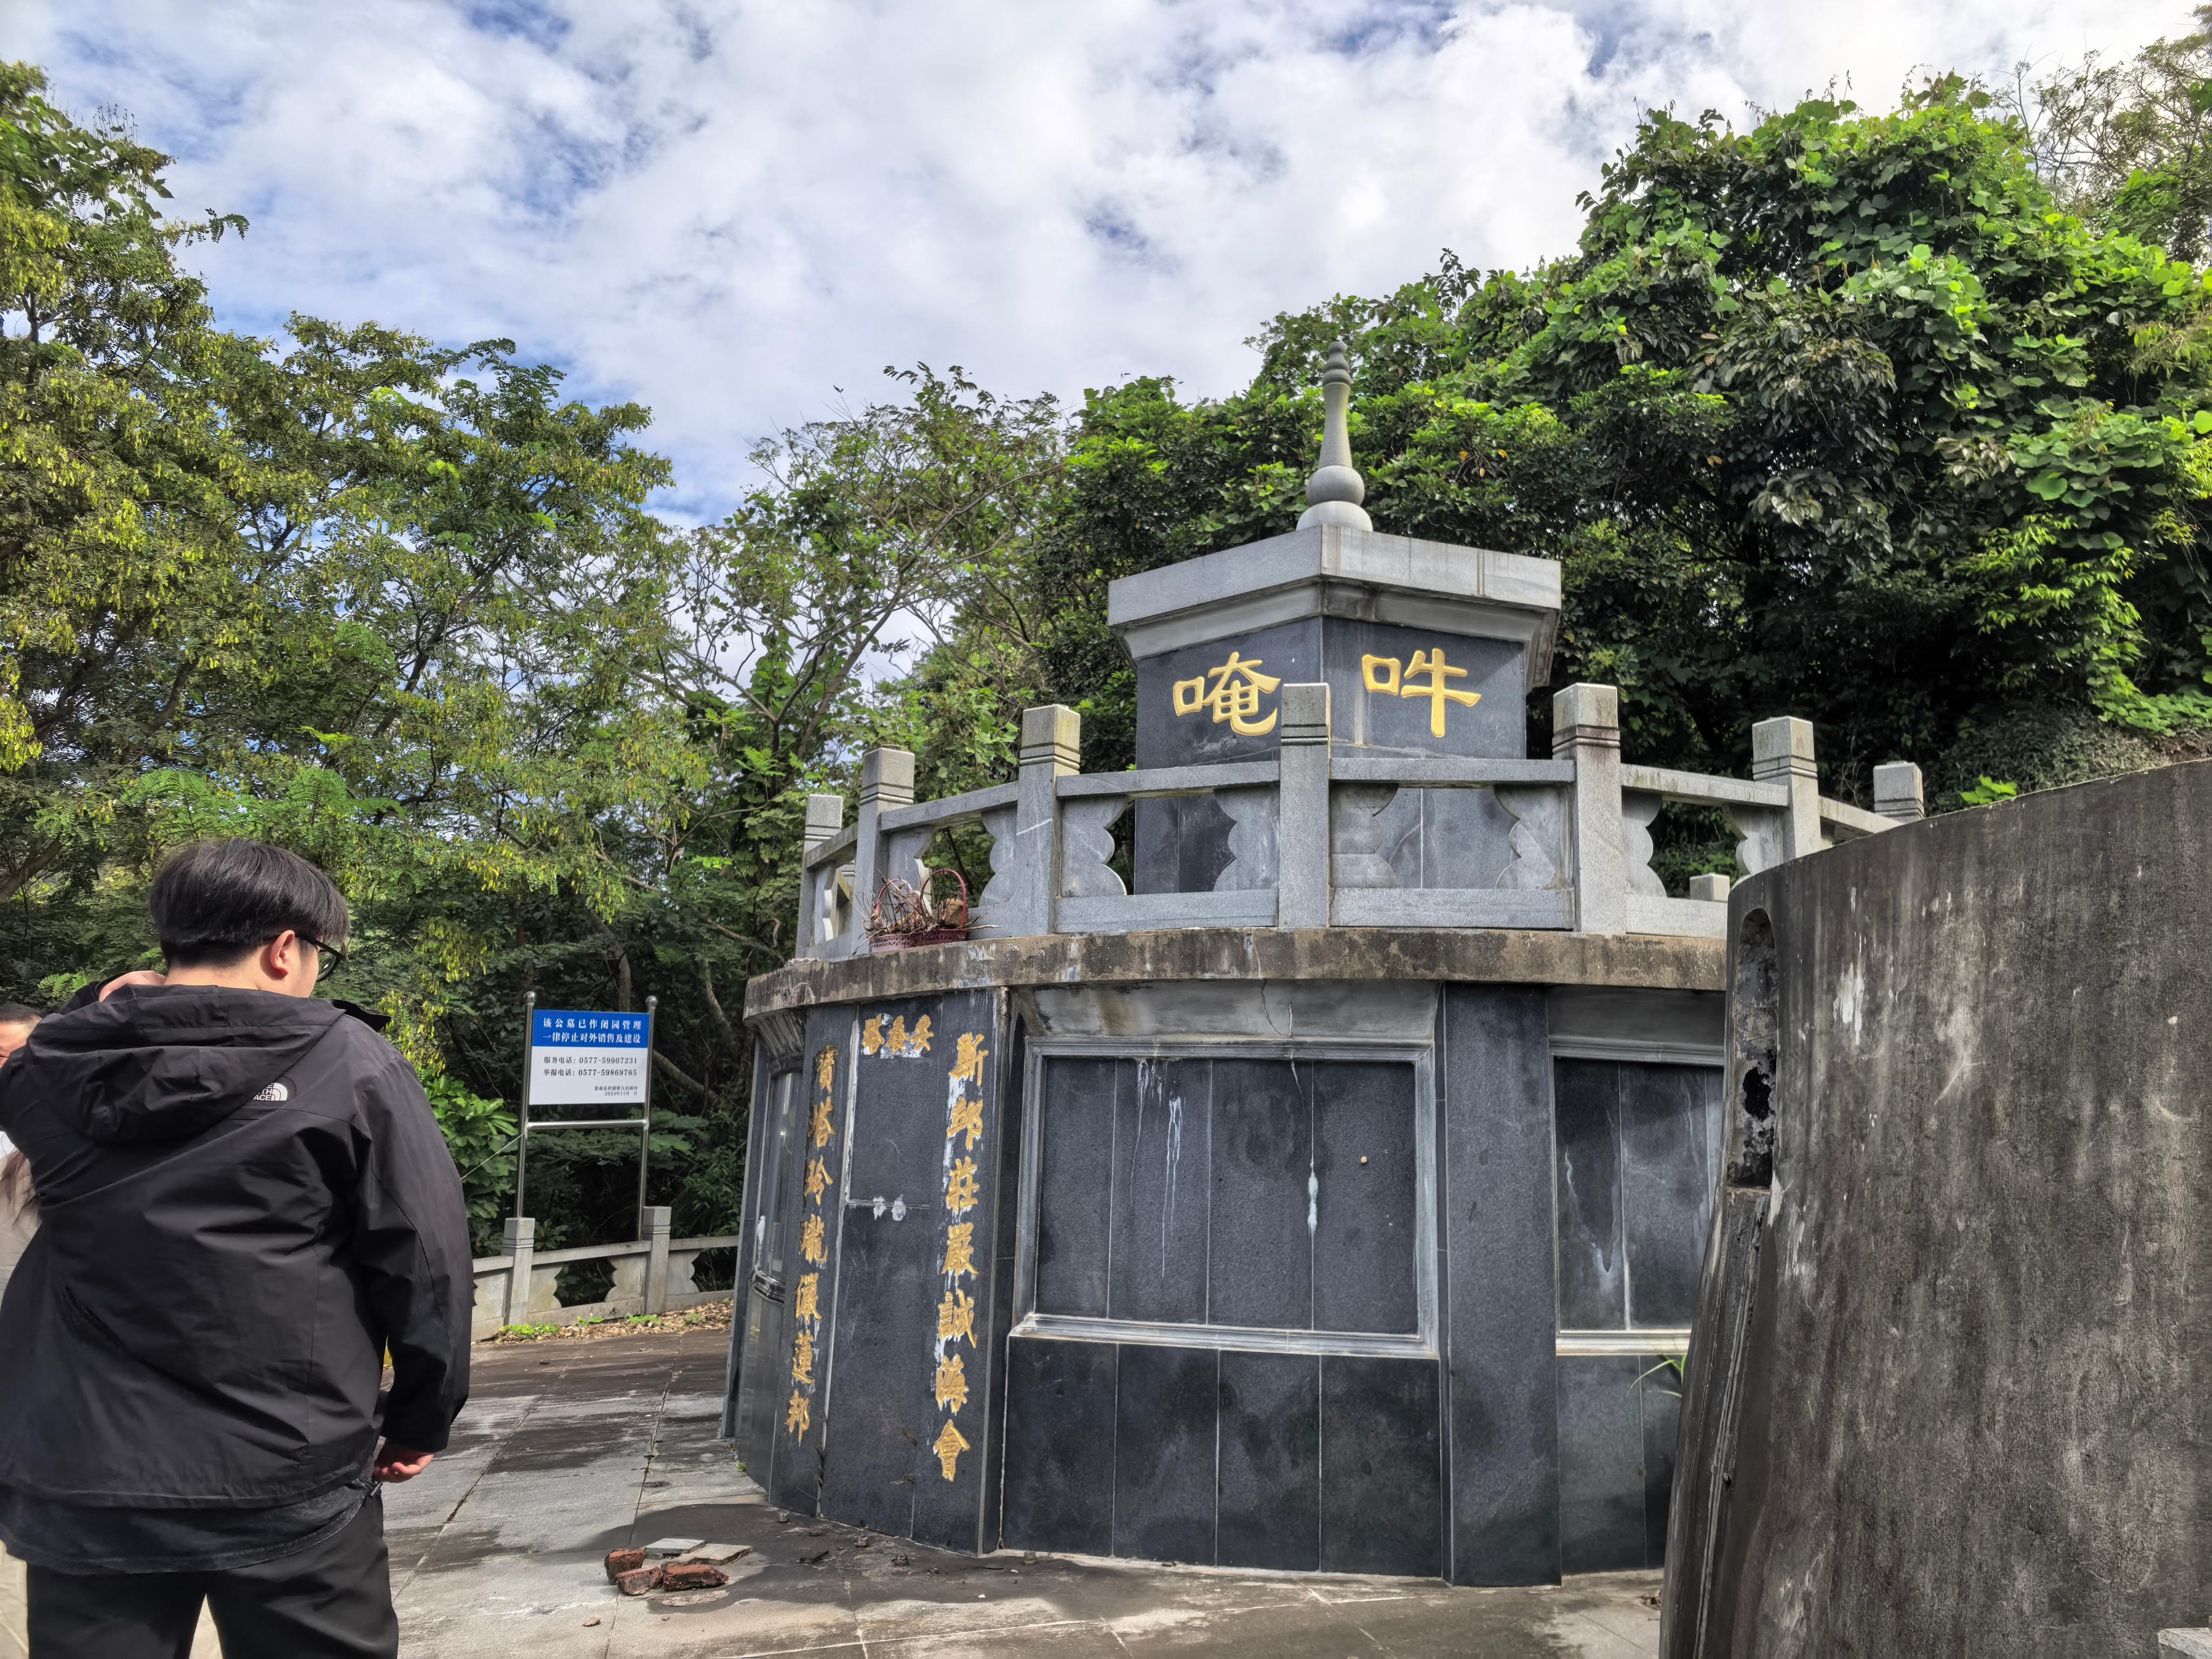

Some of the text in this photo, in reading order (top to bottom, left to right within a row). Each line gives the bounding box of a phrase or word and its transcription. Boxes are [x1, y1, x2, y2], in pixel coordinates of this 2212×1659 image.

[1172, 651, 1282, 736] 唵
[1361, 648, 1482, 738] 吽
[542, 1032, 641, 1043] 一律停止对外销售及建设
[543, 1018, 642, 1030] 该公墓已作闭园管理
